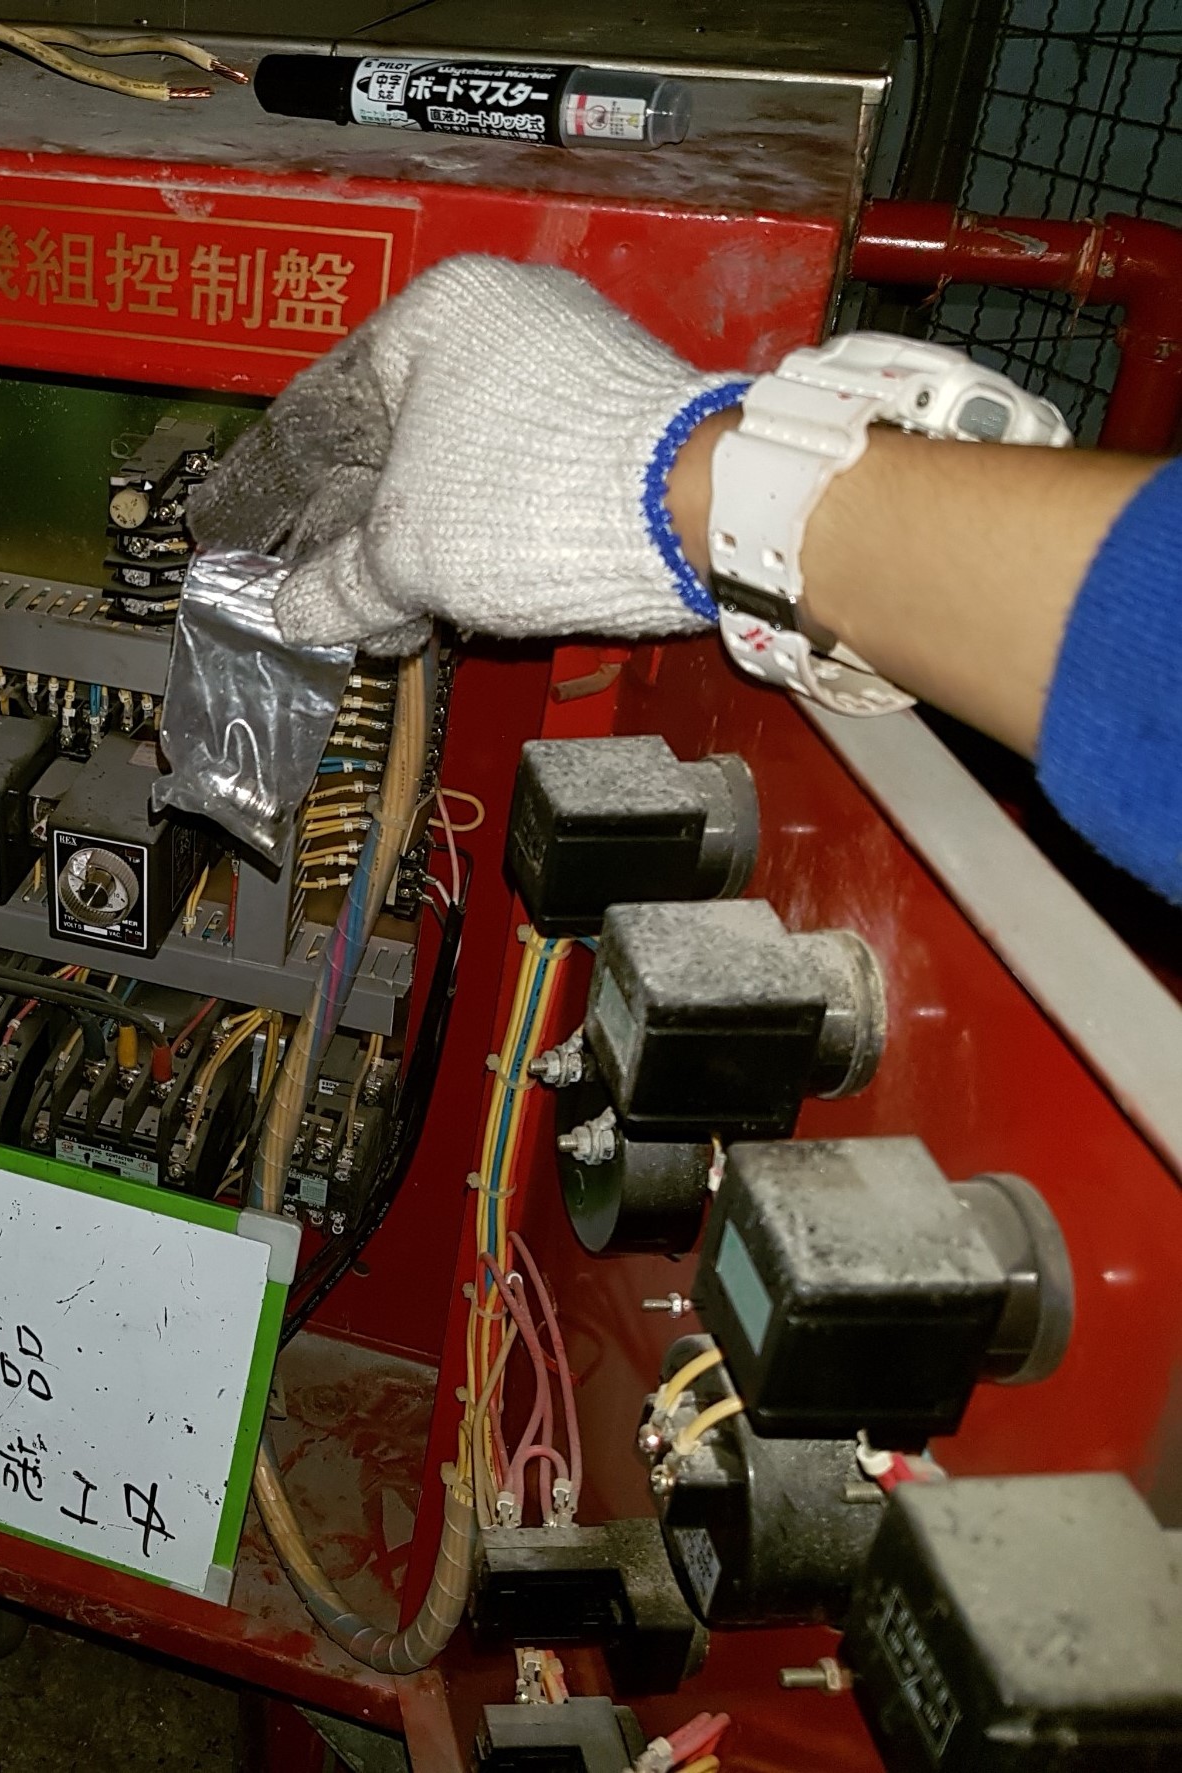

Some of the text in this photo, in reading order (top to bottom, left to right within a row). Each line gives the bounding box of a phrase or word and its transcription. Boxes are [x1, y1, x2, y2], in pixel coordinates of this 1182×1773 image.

[377, 62, 413, 70] PILOT
[376, 73, 402, 90] 中字
[505, 70, 557, 80] Marker
[407, 76, 550, 108] ボードマスター
[427, 106, 545, 133] 直液カートリッジ式
[105, 1152, 134, 1163] CONTACTOR
